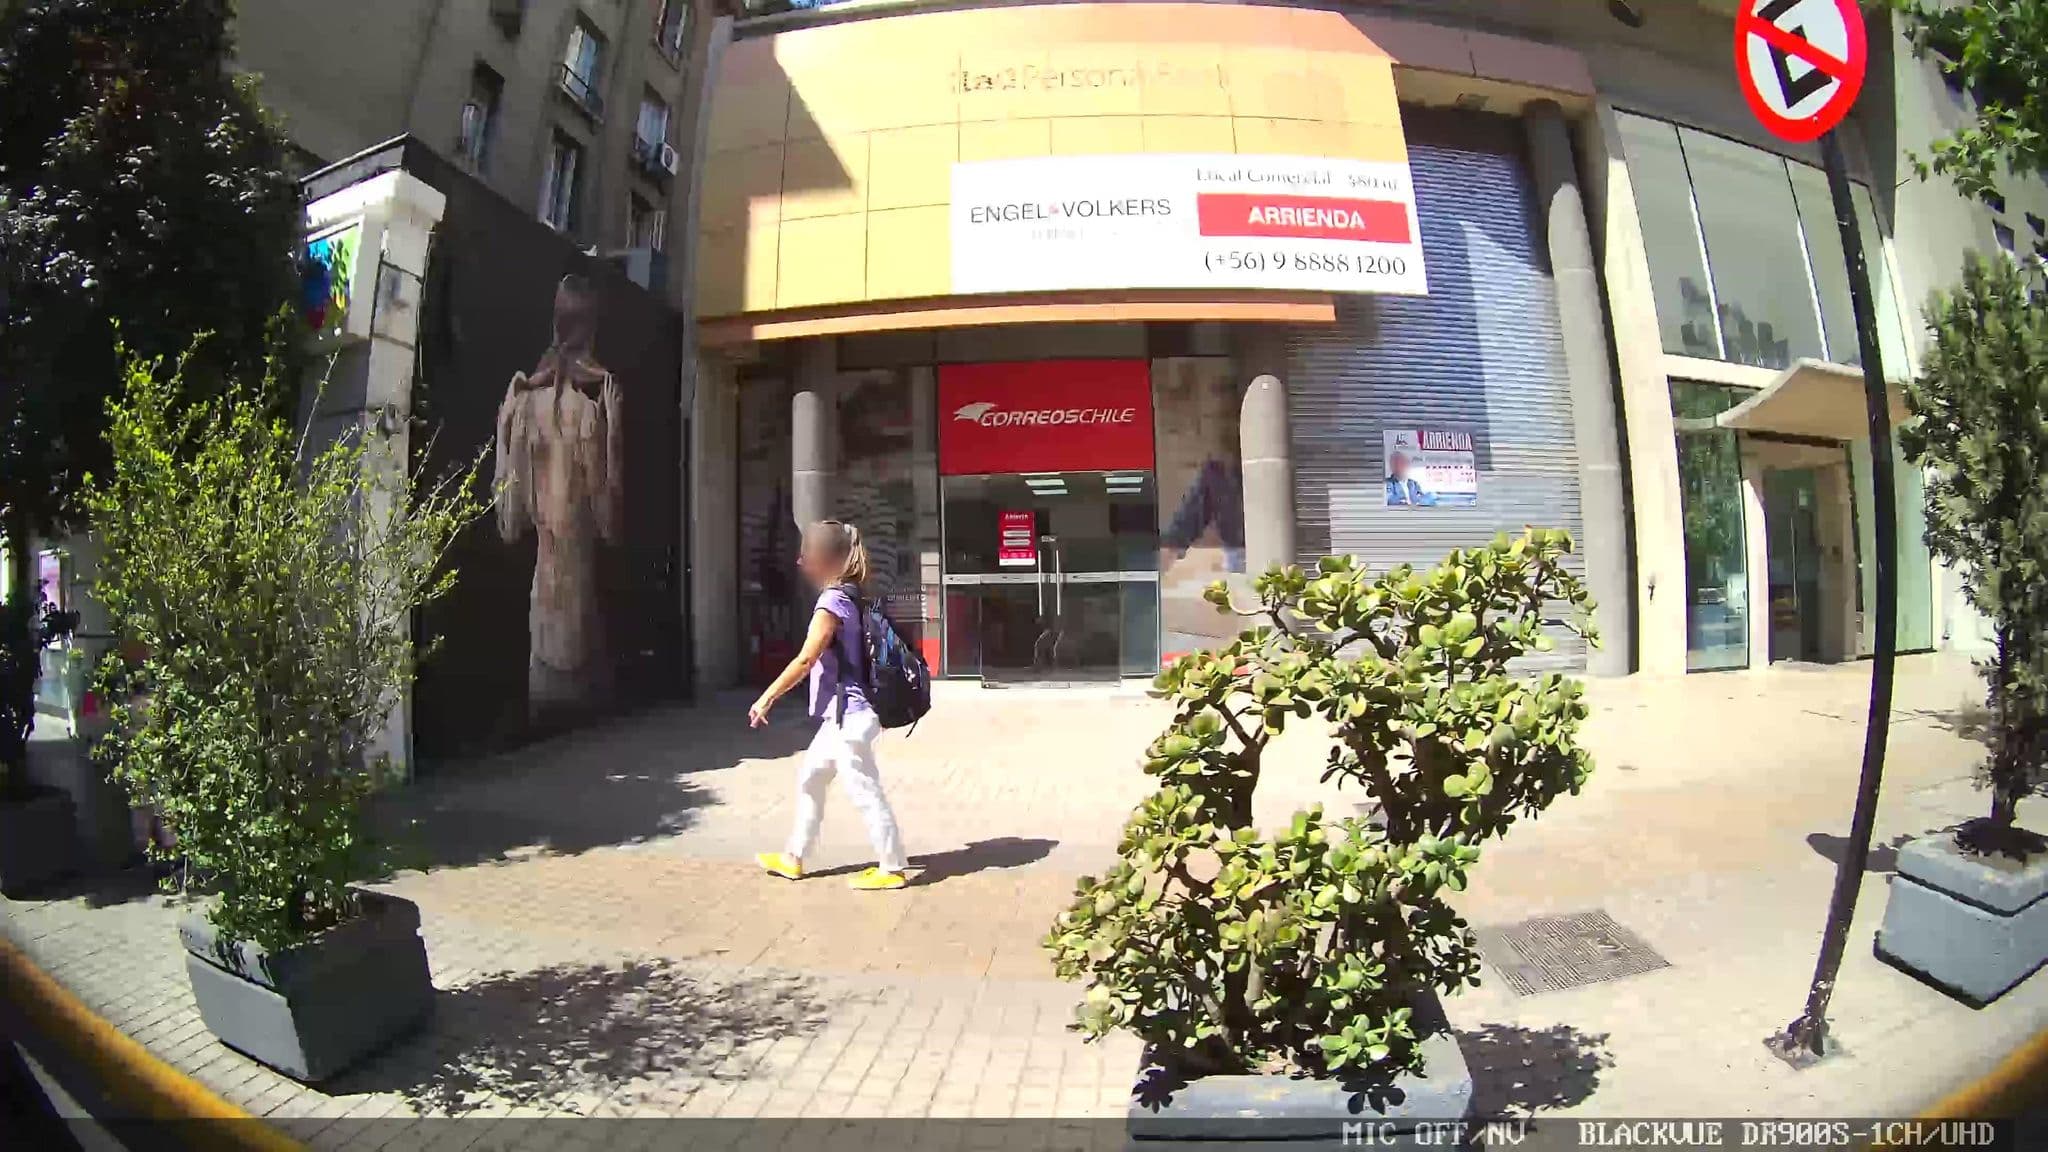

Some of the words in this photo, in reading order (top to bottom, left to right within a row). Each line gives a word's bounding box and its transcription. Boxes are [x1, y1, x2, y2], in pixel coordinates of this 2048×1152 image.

[970, 203, 1049, 224] ENGEL
[1248, 206, 1367, 229] ARRIENDA
[1204, 250, 1266, 272] (+56)
[1272, 252, 1287, 269] 9
[1294, 252, 1350, 273] 8888
[1357, 255, 1407, 276] 1200
[980, 407, 1137, 427] CORREOSCHILE
[1422, 430, 1473, 450] ARRIENDA
